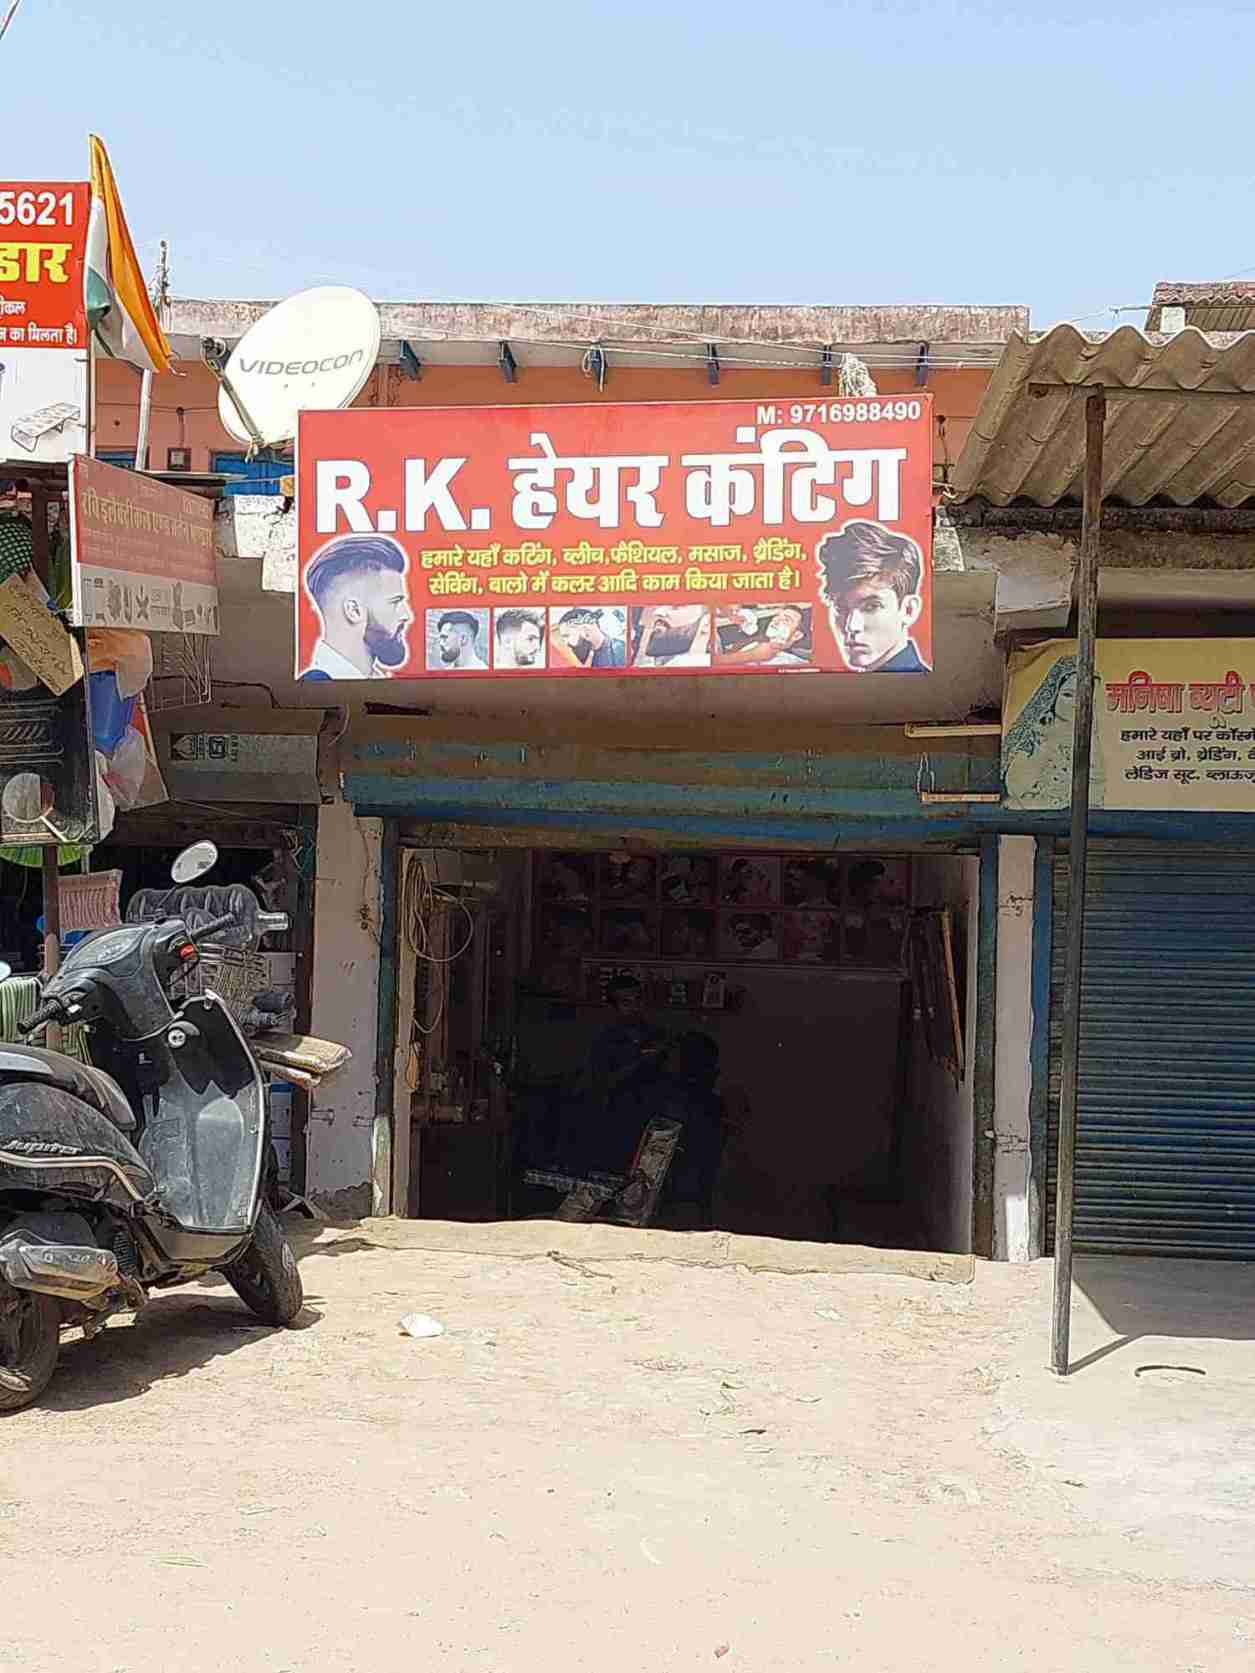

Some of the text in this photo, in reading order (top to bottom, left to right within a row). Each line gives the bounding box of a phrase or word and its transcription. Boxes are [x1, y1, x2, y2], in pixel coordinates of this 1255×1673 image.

[756, 401, 921, 425] M: 9716988490
[316, 457, 490, 533] R.K.
[507, 432, 669, 528] हेयर
[421, 544, 464, 568] हमारे
[467, 543, 501, 567] यहाँ
[688, 544, 747, 563] मसाज,
[531, 571, 549, 593] में
[552, 575, 595, 593] कलर
[598, 569, 638, 592] आदि
[642, 573, 681, 591] काम
[686, 567, 727, 590] किया
[733, 571, 774, 590] जाता
[1121, 727, 1157, 742] हमारे
[1192, 729, 1212, 741] पर
[1136, 746, 1167, 762] आई
